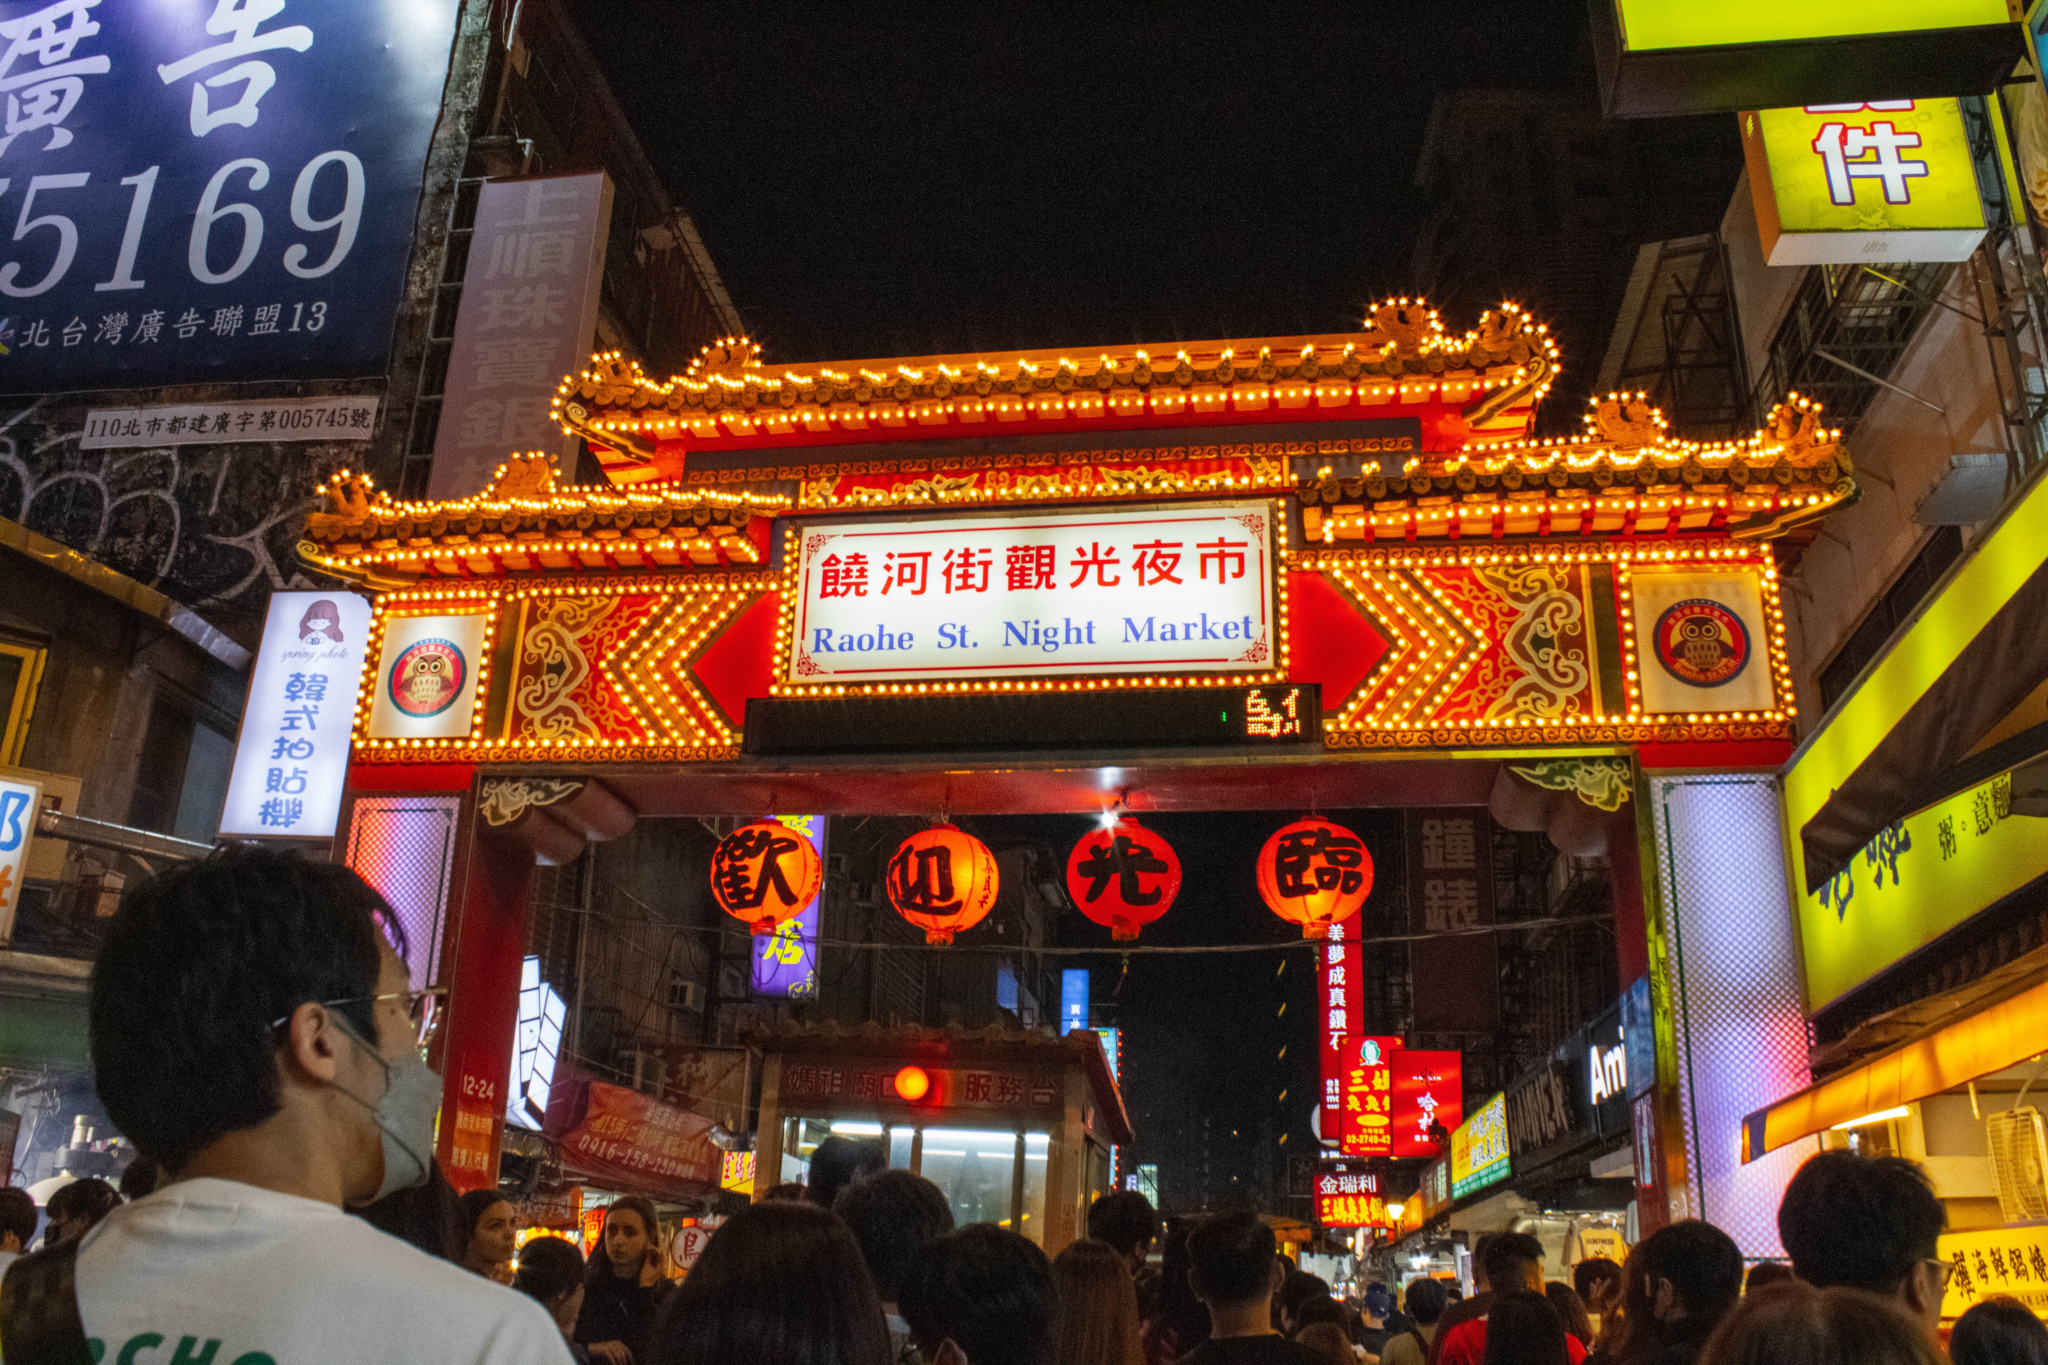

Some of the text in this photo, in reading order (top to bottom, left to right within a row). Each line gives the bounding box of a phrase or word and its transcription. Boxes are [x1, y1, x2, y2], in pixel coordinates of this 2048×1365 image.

[0, 0, 314, 152] 廣告
[1803, 99, 1928, 205] 件
[0, 150, 366, 298] 5169
[87, 407, 371, 438] 110北市都建廣字第005745號
[820, 536, 1249, 600] 饒河街觀光夜市
[280, 645, 350, 663] spring photo
[812, 613, 1255, 653] Raohe St. Night Market
[259, 672, 329, 829] 韓式拍貼機
[712, 829, 799, 913] 歡
[888, 845, 963, 917] 迎
[1077, 835, 1169, 906] 光
[1275, 827, 1363, 898] 臨
[965, 1073, 1059, 1106] 服務台
[1590, 1025, 1627, 1106] Ami
[1319, 1174, 1377, 1195] 金瑞利
